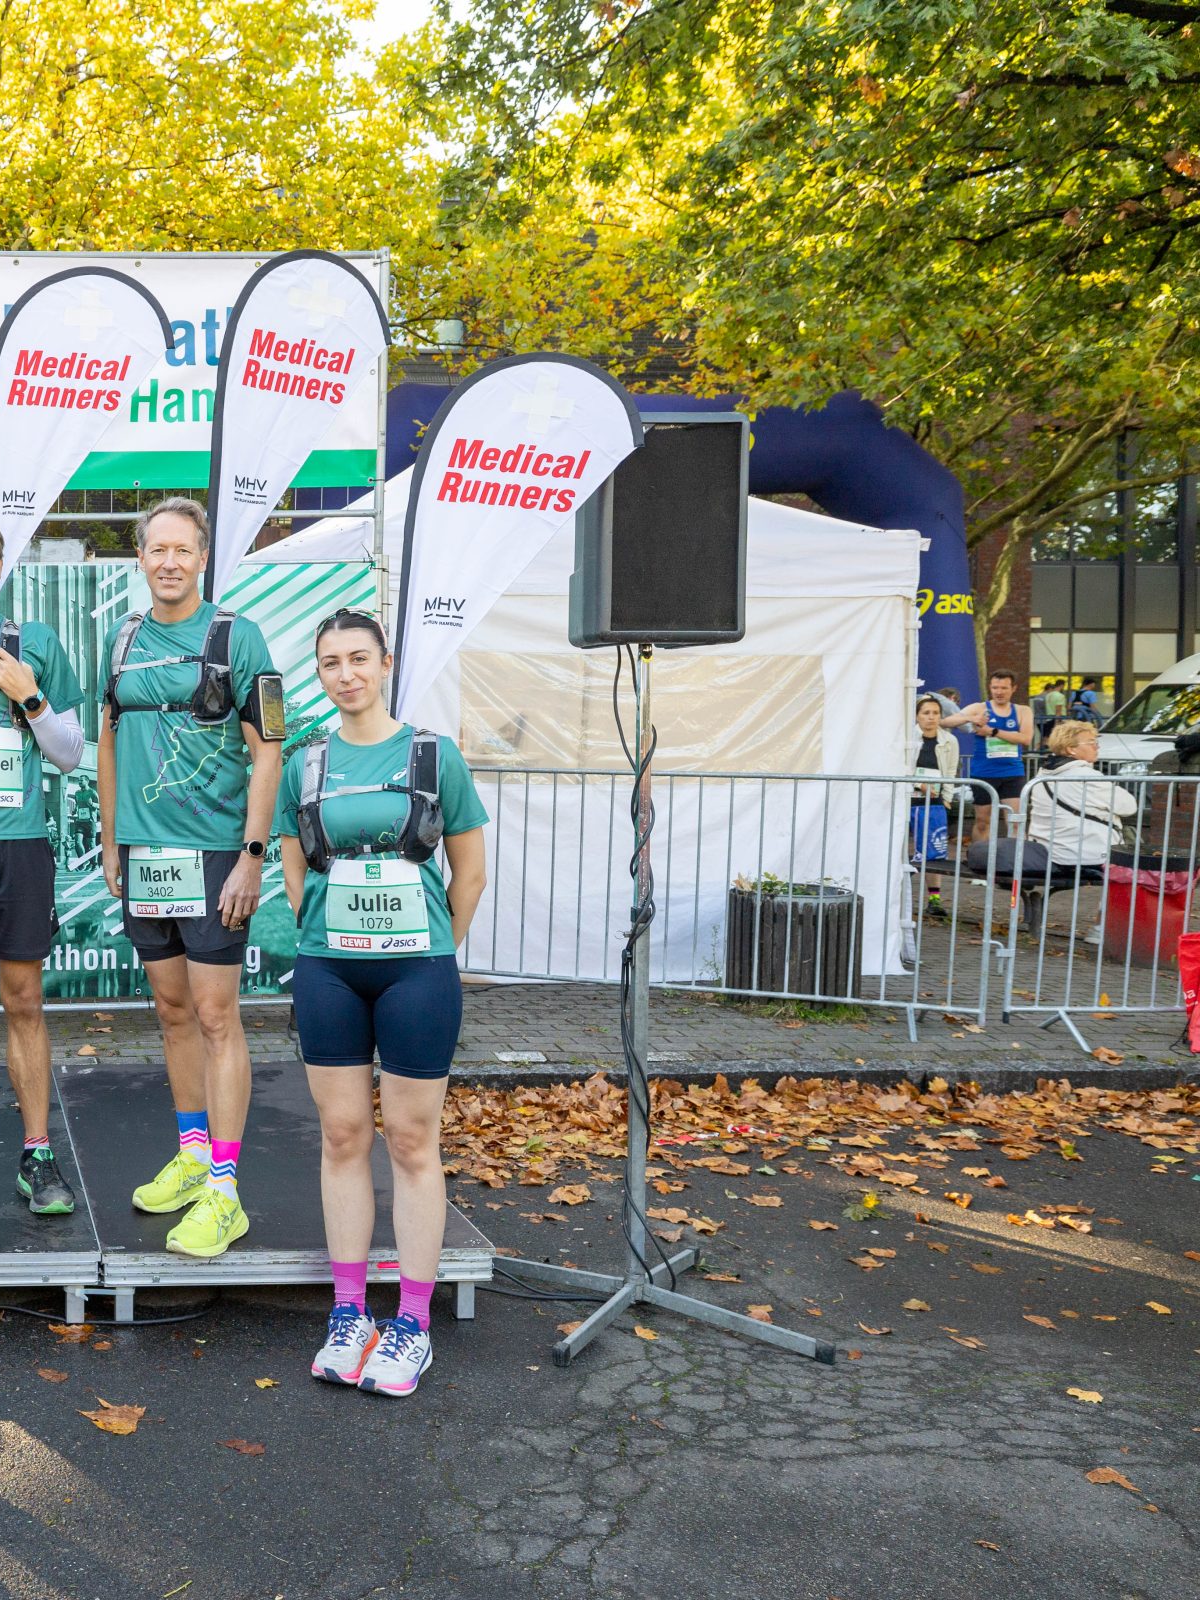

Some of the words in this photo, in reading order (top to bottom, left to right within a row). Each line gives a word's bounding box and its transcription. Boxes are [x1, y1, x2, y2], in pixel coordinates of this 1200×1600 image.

[248, 328, 355, 375] Medical
[14, 349, 132, 382] Medical
[242, 359, 347, 405] Runners
[6, 379, 122, 412] Runners
[447, 438, 592, 480] Medical
[234, 475, 267, 491] MHV
[2, 490, 36, 503] MHV
[436, 472, 577, 513] Runners
[424, 596, 466, 612] MHV
[934, 593, 974, 615] asic
[140, 865, 182, 882] Mark
[147, 886, 174, 897] 3402
[137, 905, 158, 914] REWE
[174, 904, 195, 913] asics
[347, 893, 402, 912] Julia
[359, 917, 393, 930] 1079
[341, 937, 370, 948] REWE
[393, 938, 417, 947] asics
